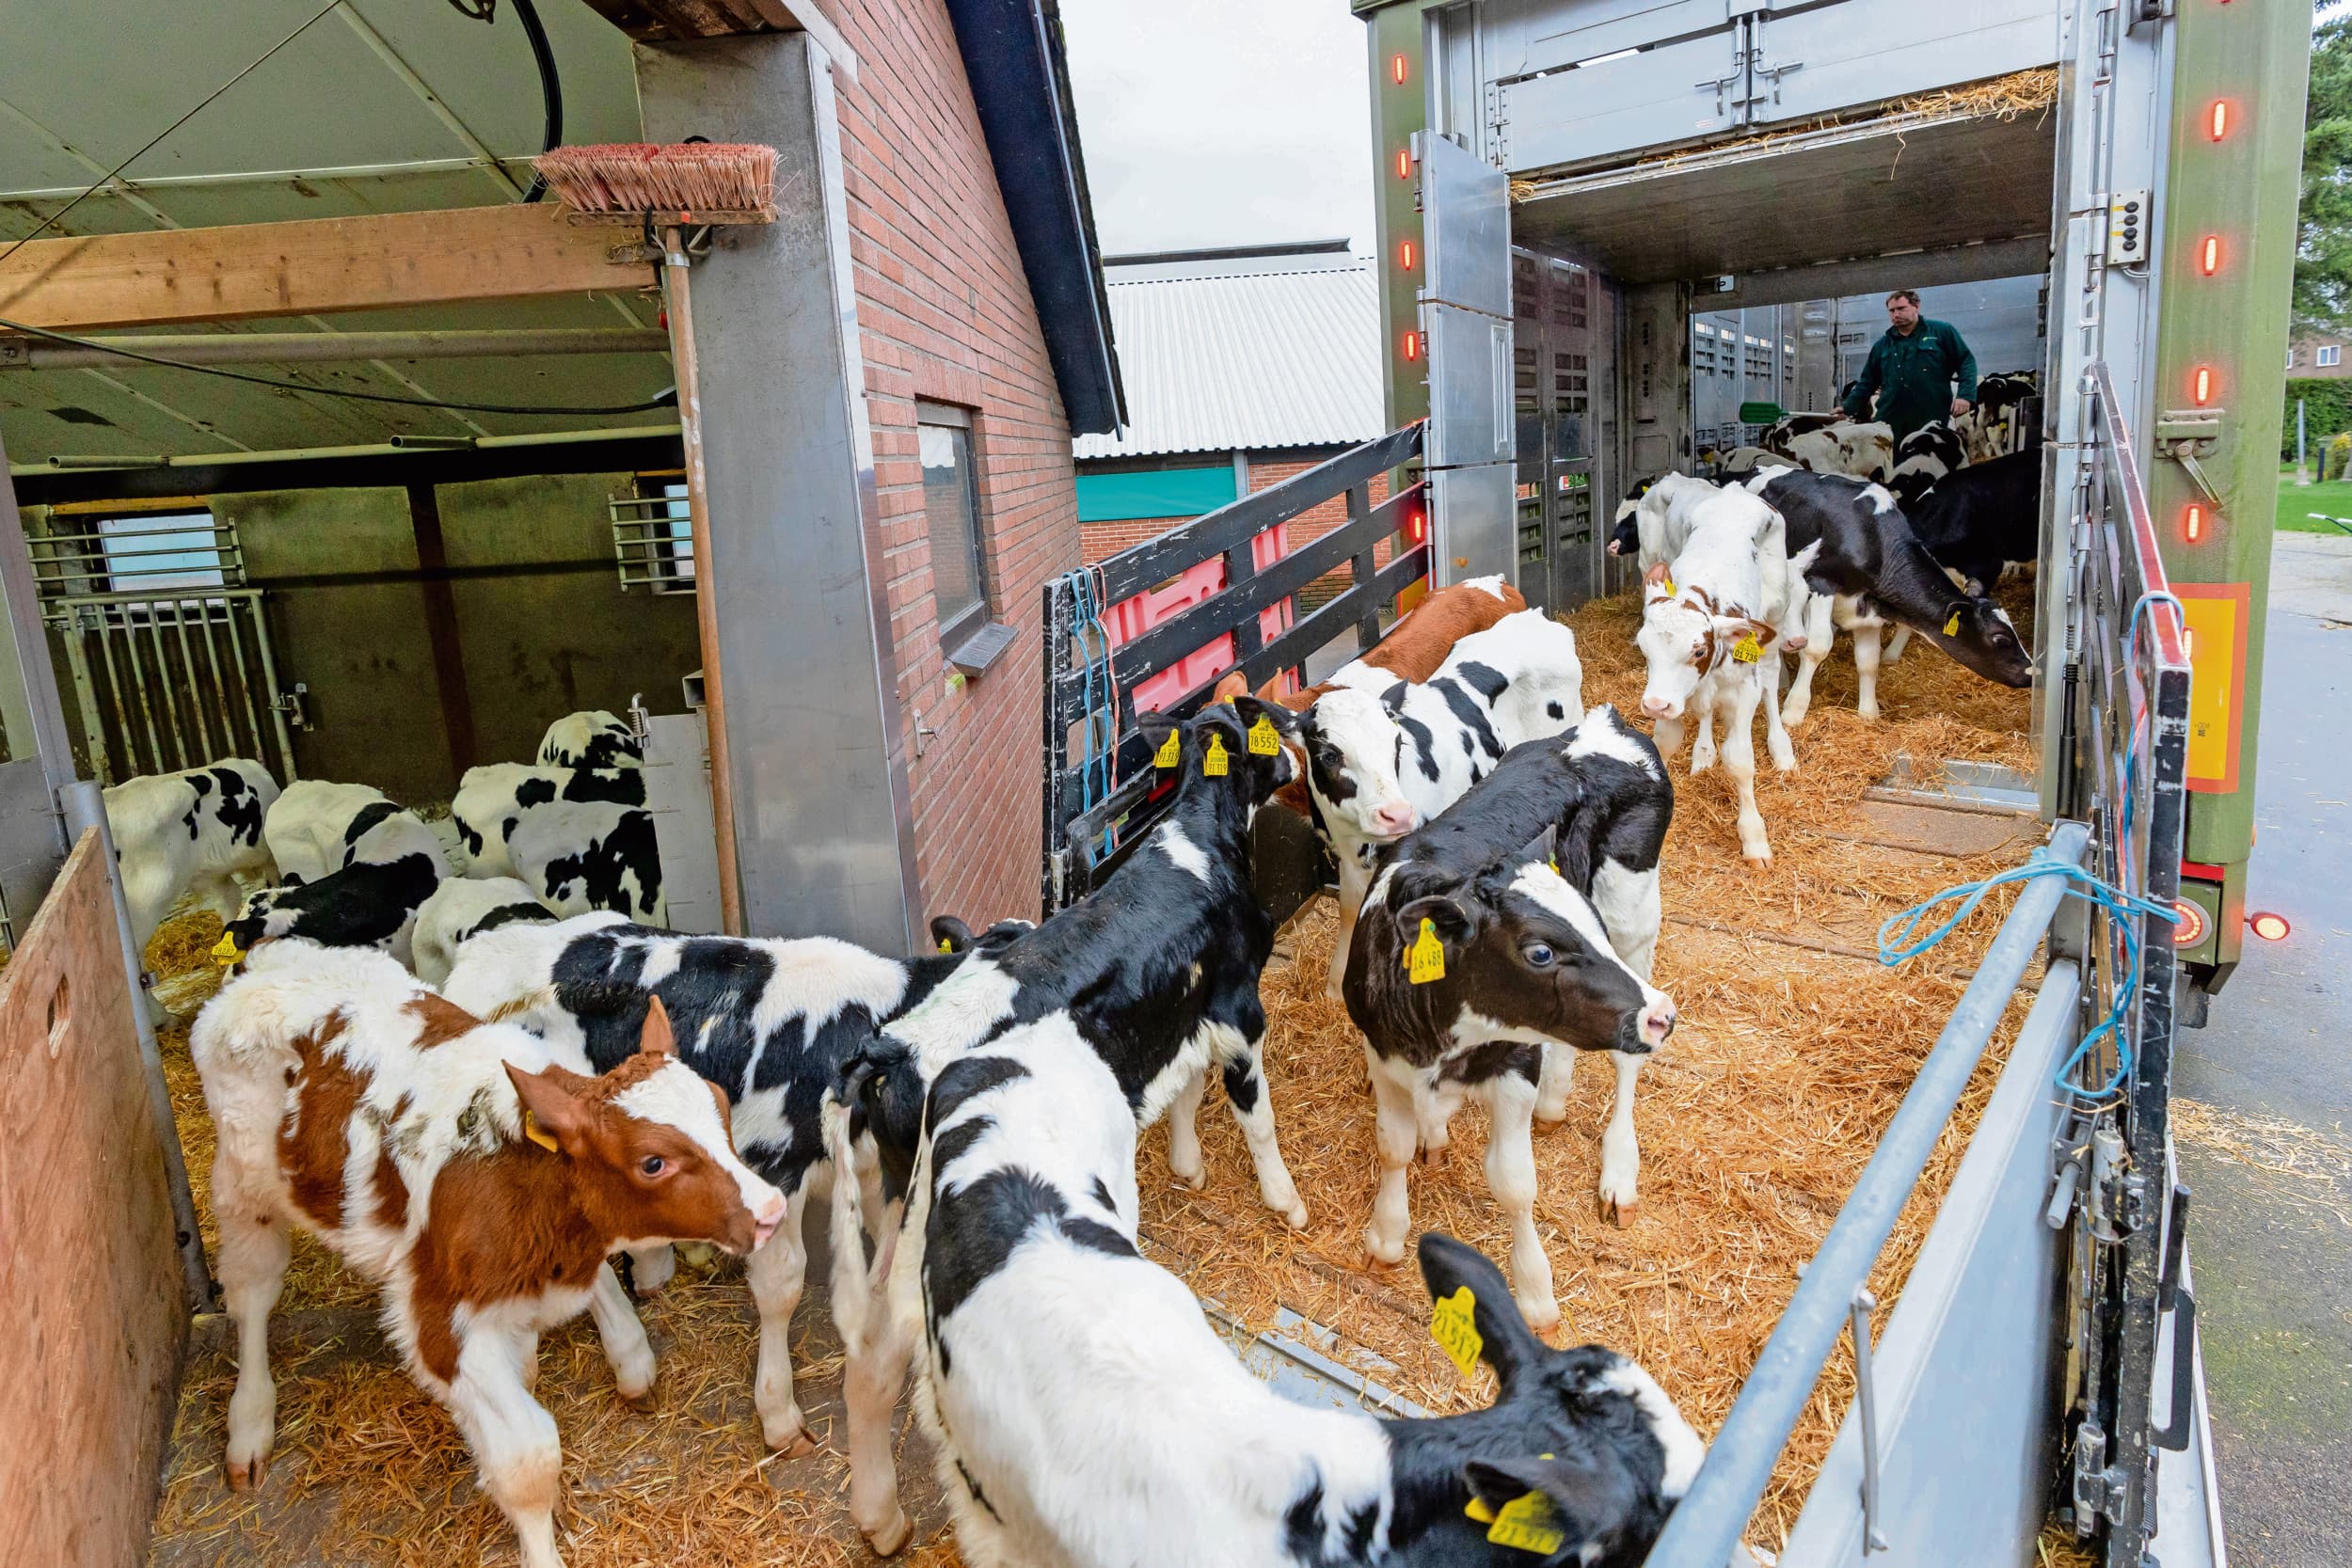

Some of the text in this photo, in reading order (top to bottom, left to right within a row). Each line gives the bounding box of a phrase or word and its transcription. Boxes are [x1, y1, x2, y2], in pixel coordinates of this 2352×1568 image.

[1735, 649, 1758, 662] 01 735
[1249, 736, 1278, 749] 78 552
